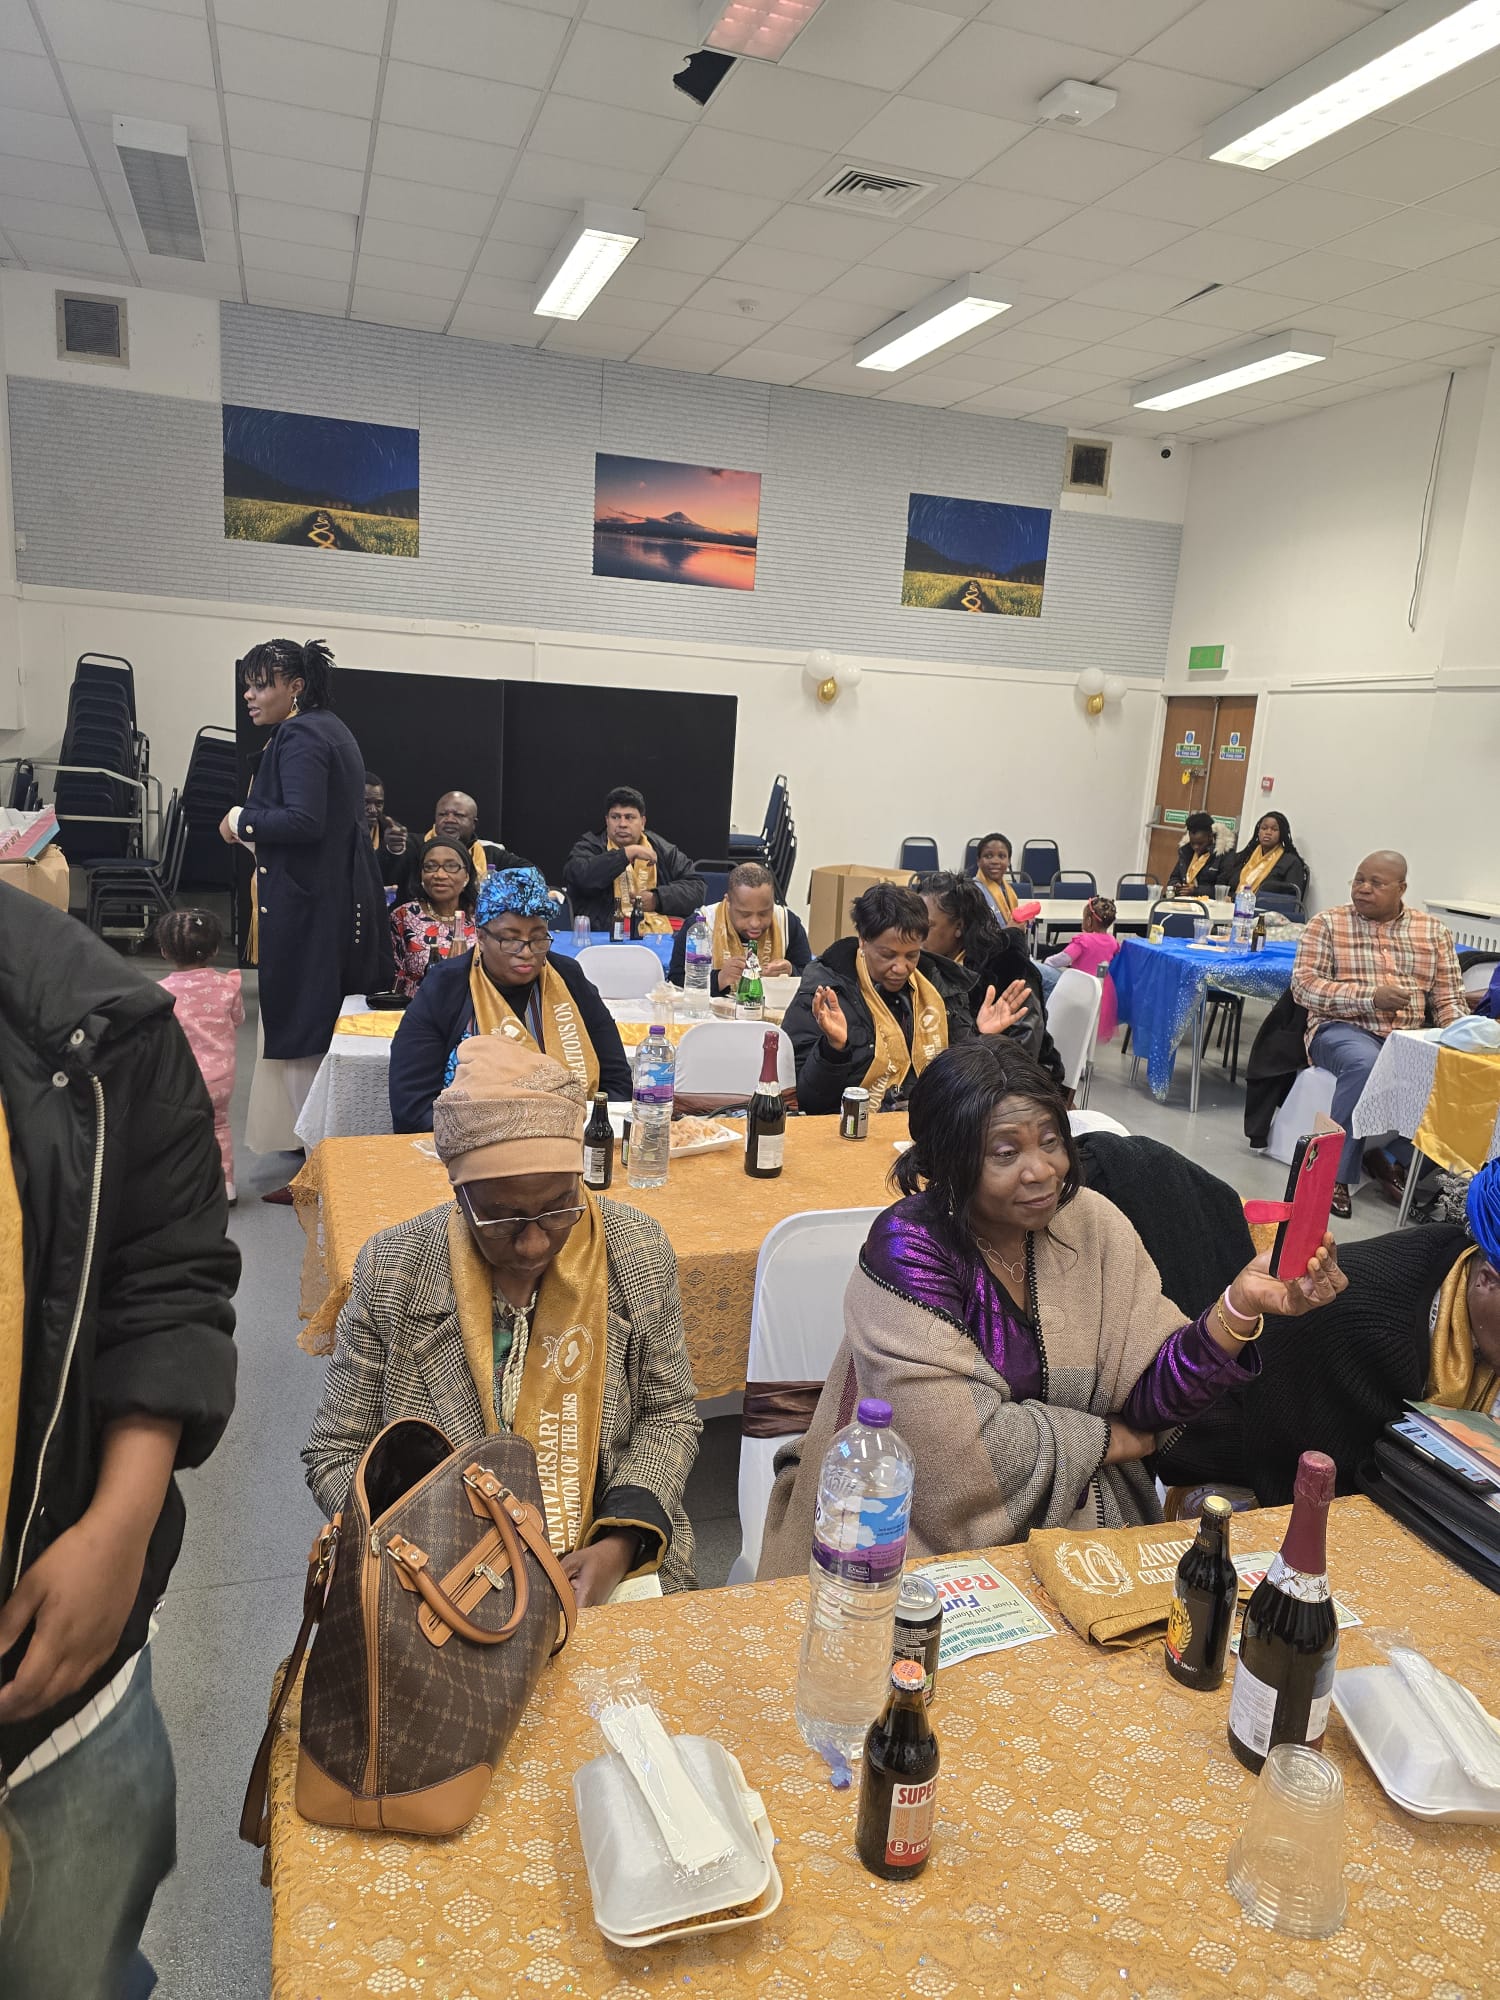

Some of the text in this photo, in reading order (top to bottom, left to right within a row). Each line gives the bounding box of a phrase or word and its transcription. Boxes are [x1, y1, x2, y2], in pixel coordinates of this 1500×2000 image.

[552, 1002, 574, 1022] ON
[562, 1393, 578, 1421] BMS
[560, 1423, 578, 1453] THE
[560, 1453, 578, 1472] OF
[975, 1604, 992, 1615] And
[992, 1599, 1020, 1610] Prison
[895, 1841, 904, 1852] B
